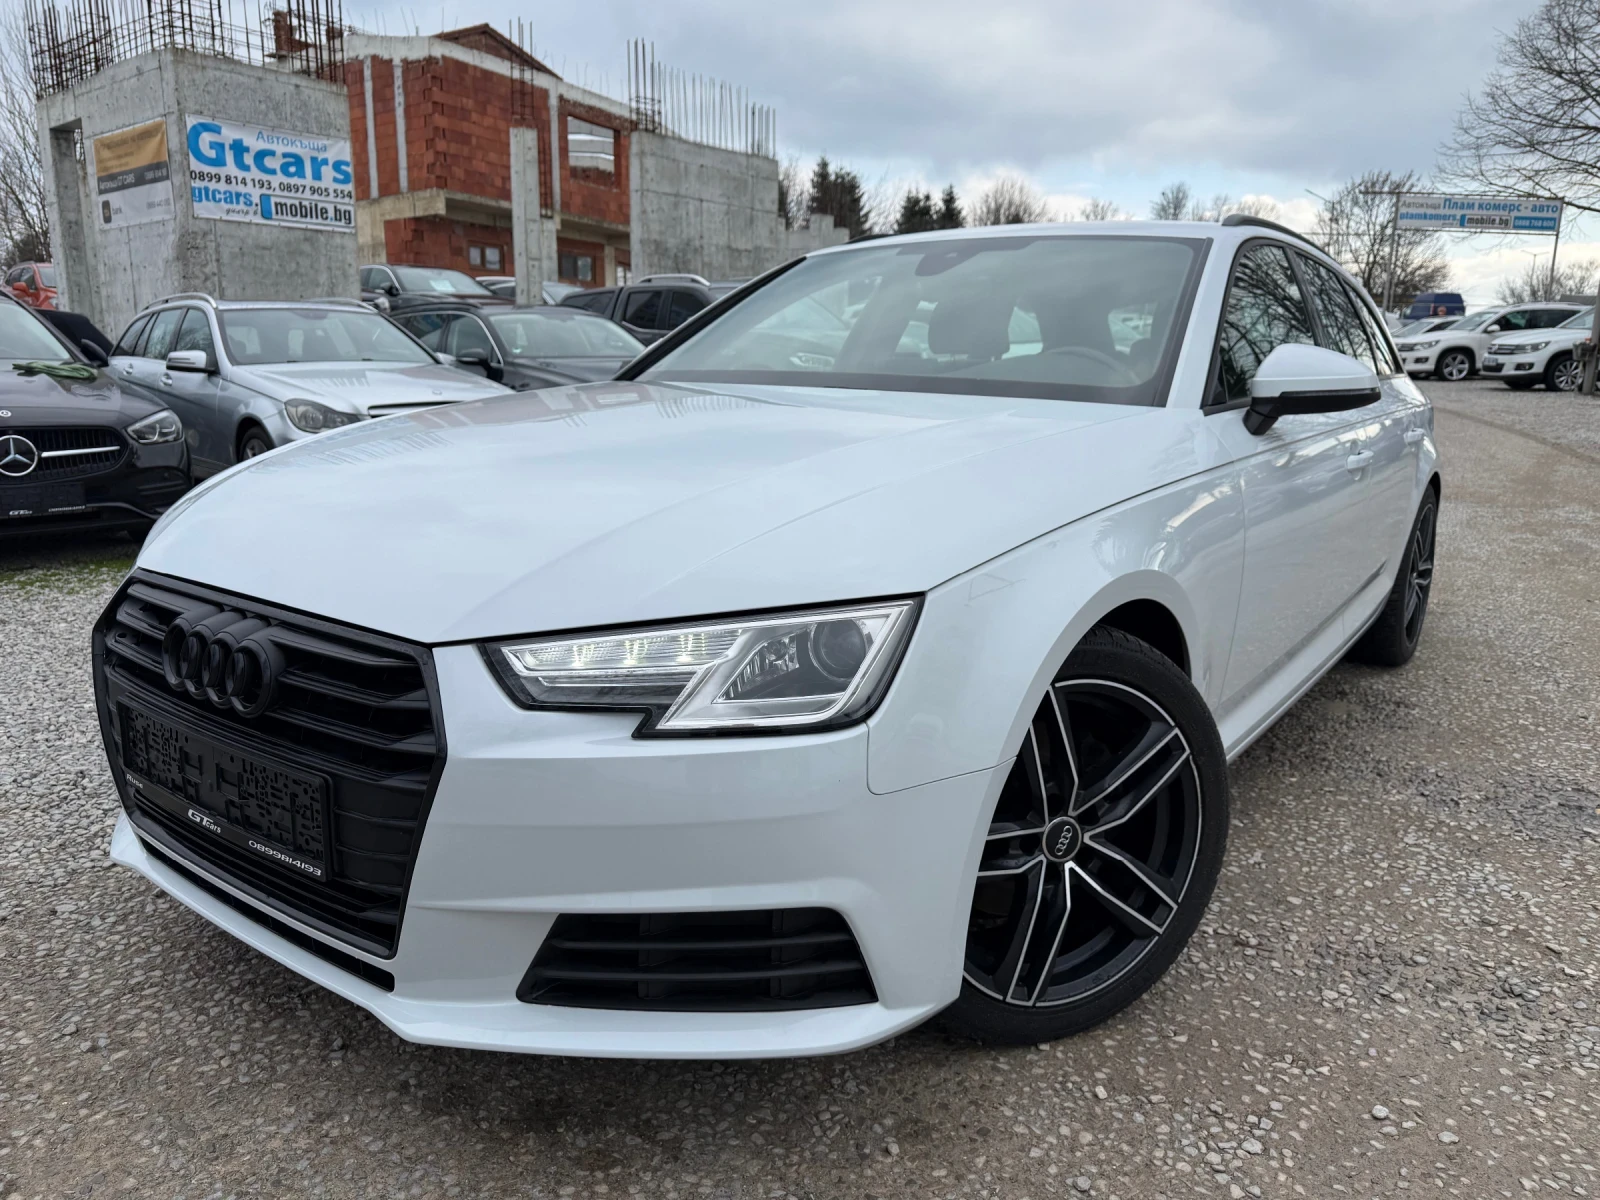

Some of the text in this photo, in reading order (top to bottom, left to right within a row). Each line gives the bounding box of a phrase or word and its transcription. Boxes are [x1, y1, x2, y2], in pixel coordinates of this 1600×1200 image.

[187, 121, 352, 185] Gtcars
[256, 130, 327, 153] Автокъща
[190, 170, 352, 200] 0899 814 193, 0897 905 554
[274, 201, 352, 225] mobile.bg
[1400, 199, 1441, 211] Автокъща
[1442, 198, 1475, 211] Плам
[1477, 201, 1522, 214] комерс
[1530, 205, 1559, 214] авто
[1466, 216, 1510, 227] mobile.bg
[126, 773, 144, 789] Ruse
[248, 839, 322, 877] 0899814193
